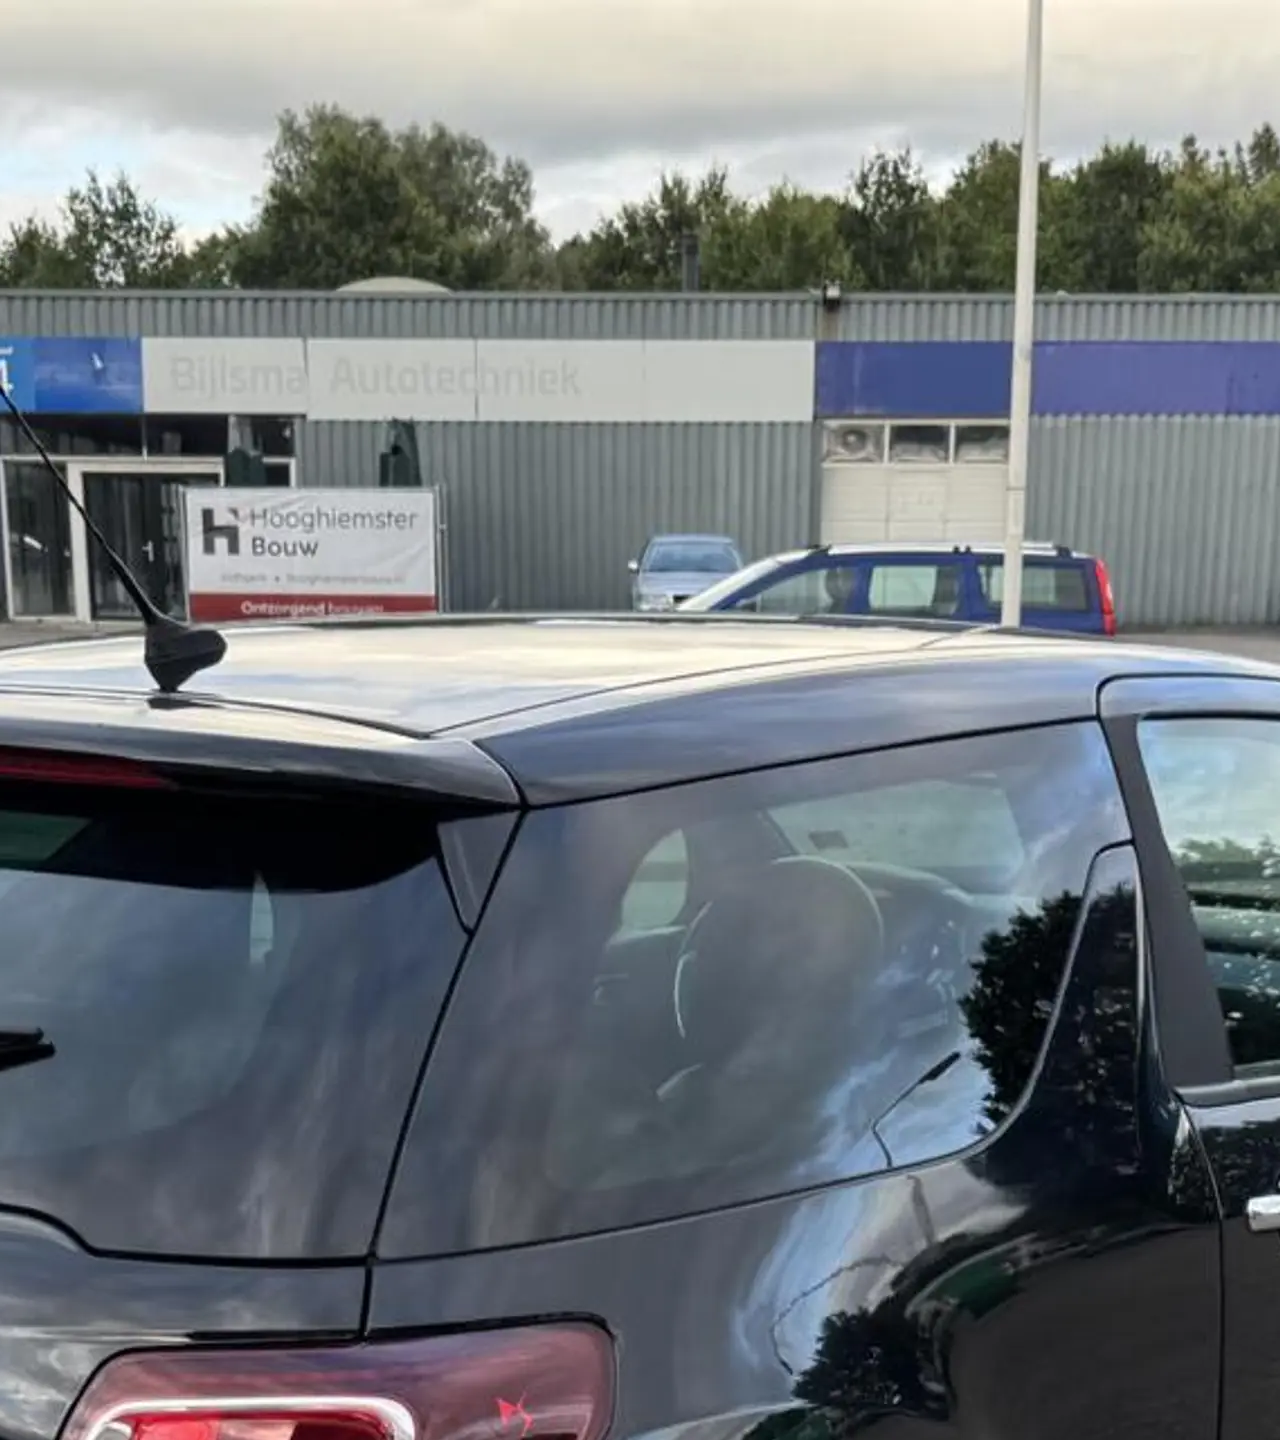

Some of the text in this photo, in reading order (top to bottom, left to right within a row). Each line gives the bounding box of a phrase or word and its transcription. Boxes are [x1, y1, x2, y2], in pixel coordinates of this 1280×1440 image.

[169, 356, 581, 397] Bijlsma Autotechniek
[250, 506, 418, 533] Hooghiemster
[251, 536, 320, 557] Bouw
